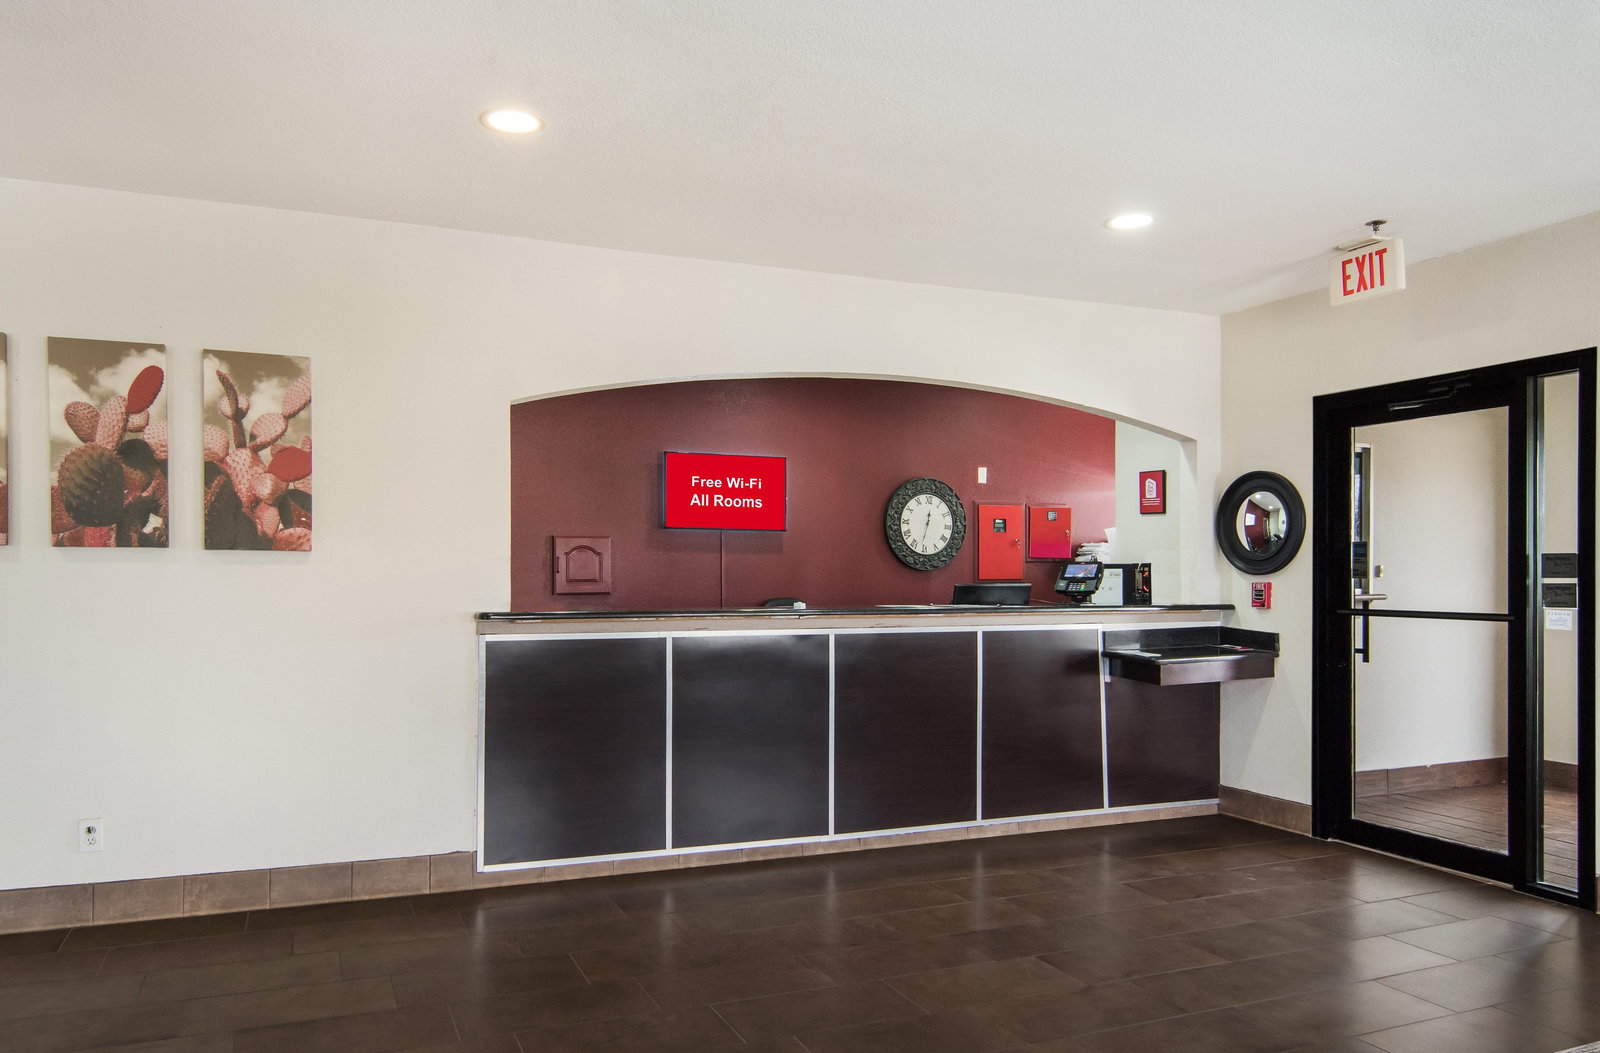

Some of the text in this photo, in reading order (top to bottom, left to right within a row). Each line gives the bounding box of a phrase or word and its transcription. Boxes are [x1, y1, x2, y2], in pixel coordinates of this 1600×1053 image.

[1341, 247, 1387, 297] EXIT
[691, 475, 762, 489] Free Wi-Fi
[690, 493, 763, 508] All Rooms
